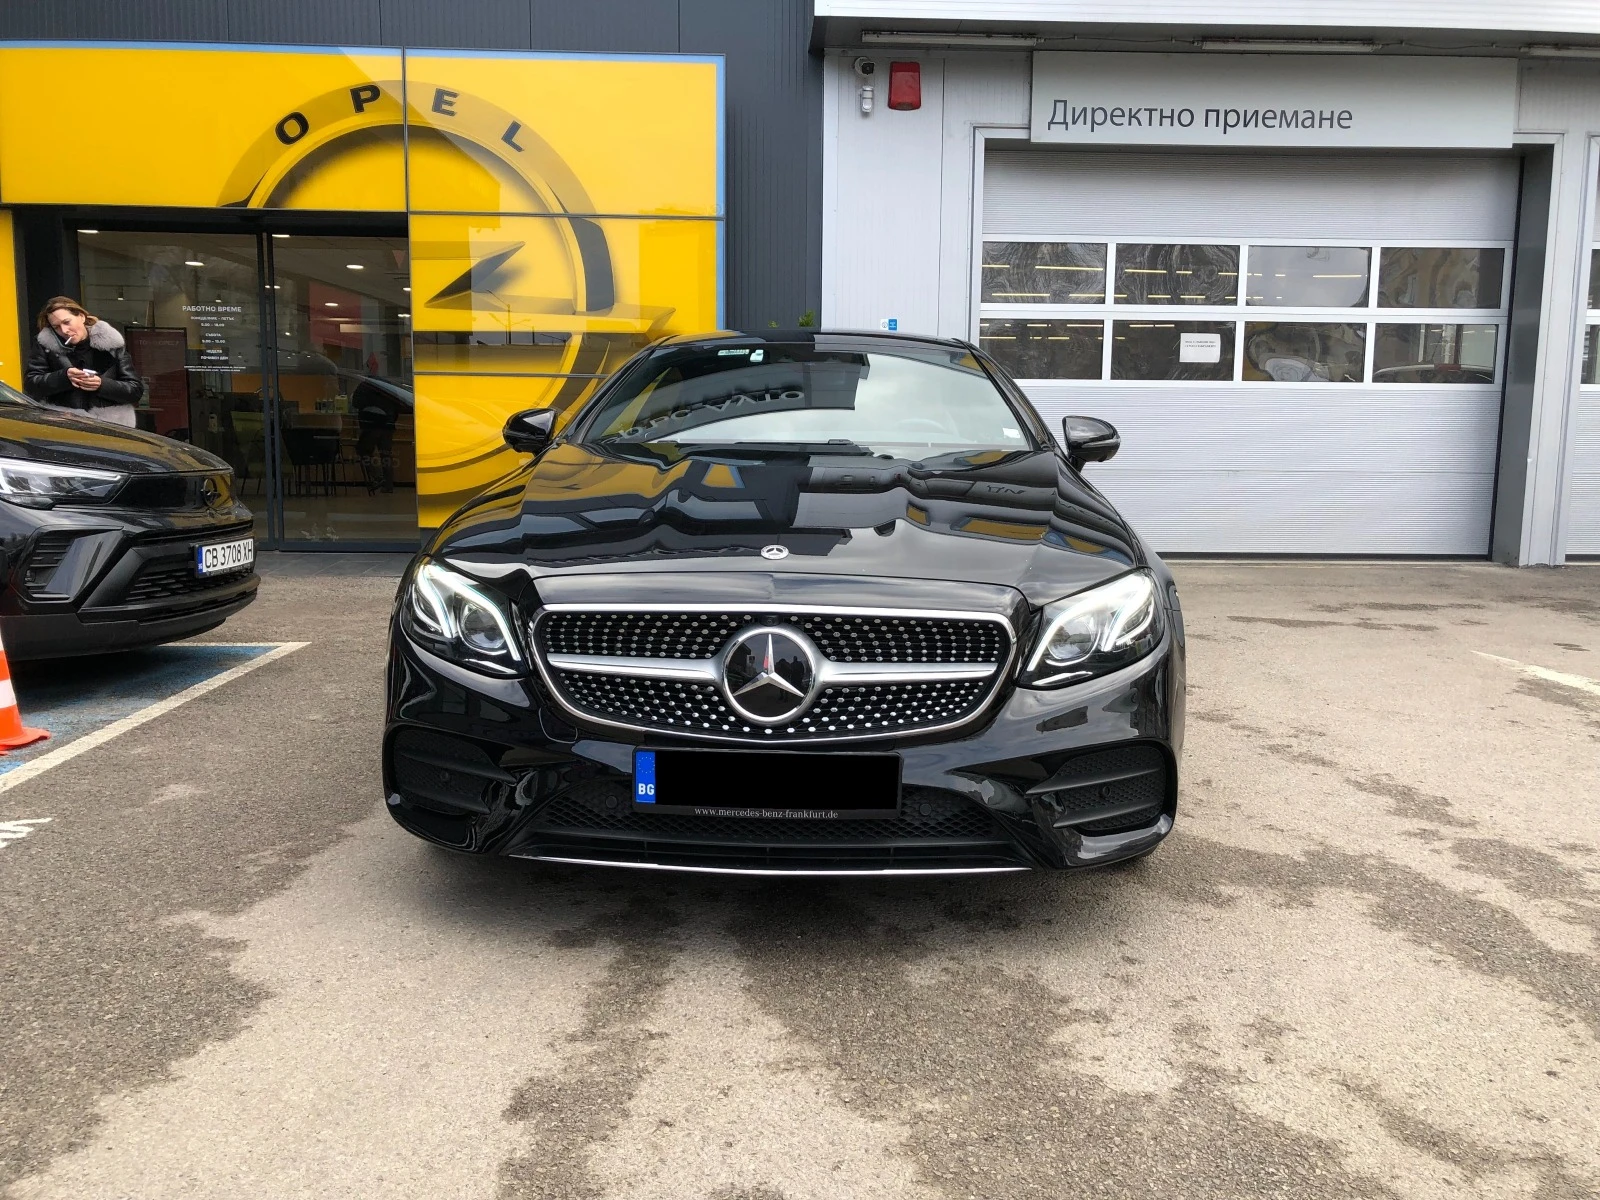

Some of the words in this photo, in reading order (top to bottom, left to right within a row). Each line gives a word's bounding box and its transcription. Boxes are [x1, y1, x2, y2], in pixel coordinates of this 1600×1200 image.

[275, 84, 525, 153] OPEL
[1047, 99, 1195, 132] Директно
[1204, 107, 1353, 134] приемане
[204, 547, 219, 569] CB
[220, 543, 242, 566] 3708
[242, 540, 253, 562] XH
[638, 783, 655, 795] BG
[694, 807, 839, 819] www.mercedes-benz-frankfurt.de
